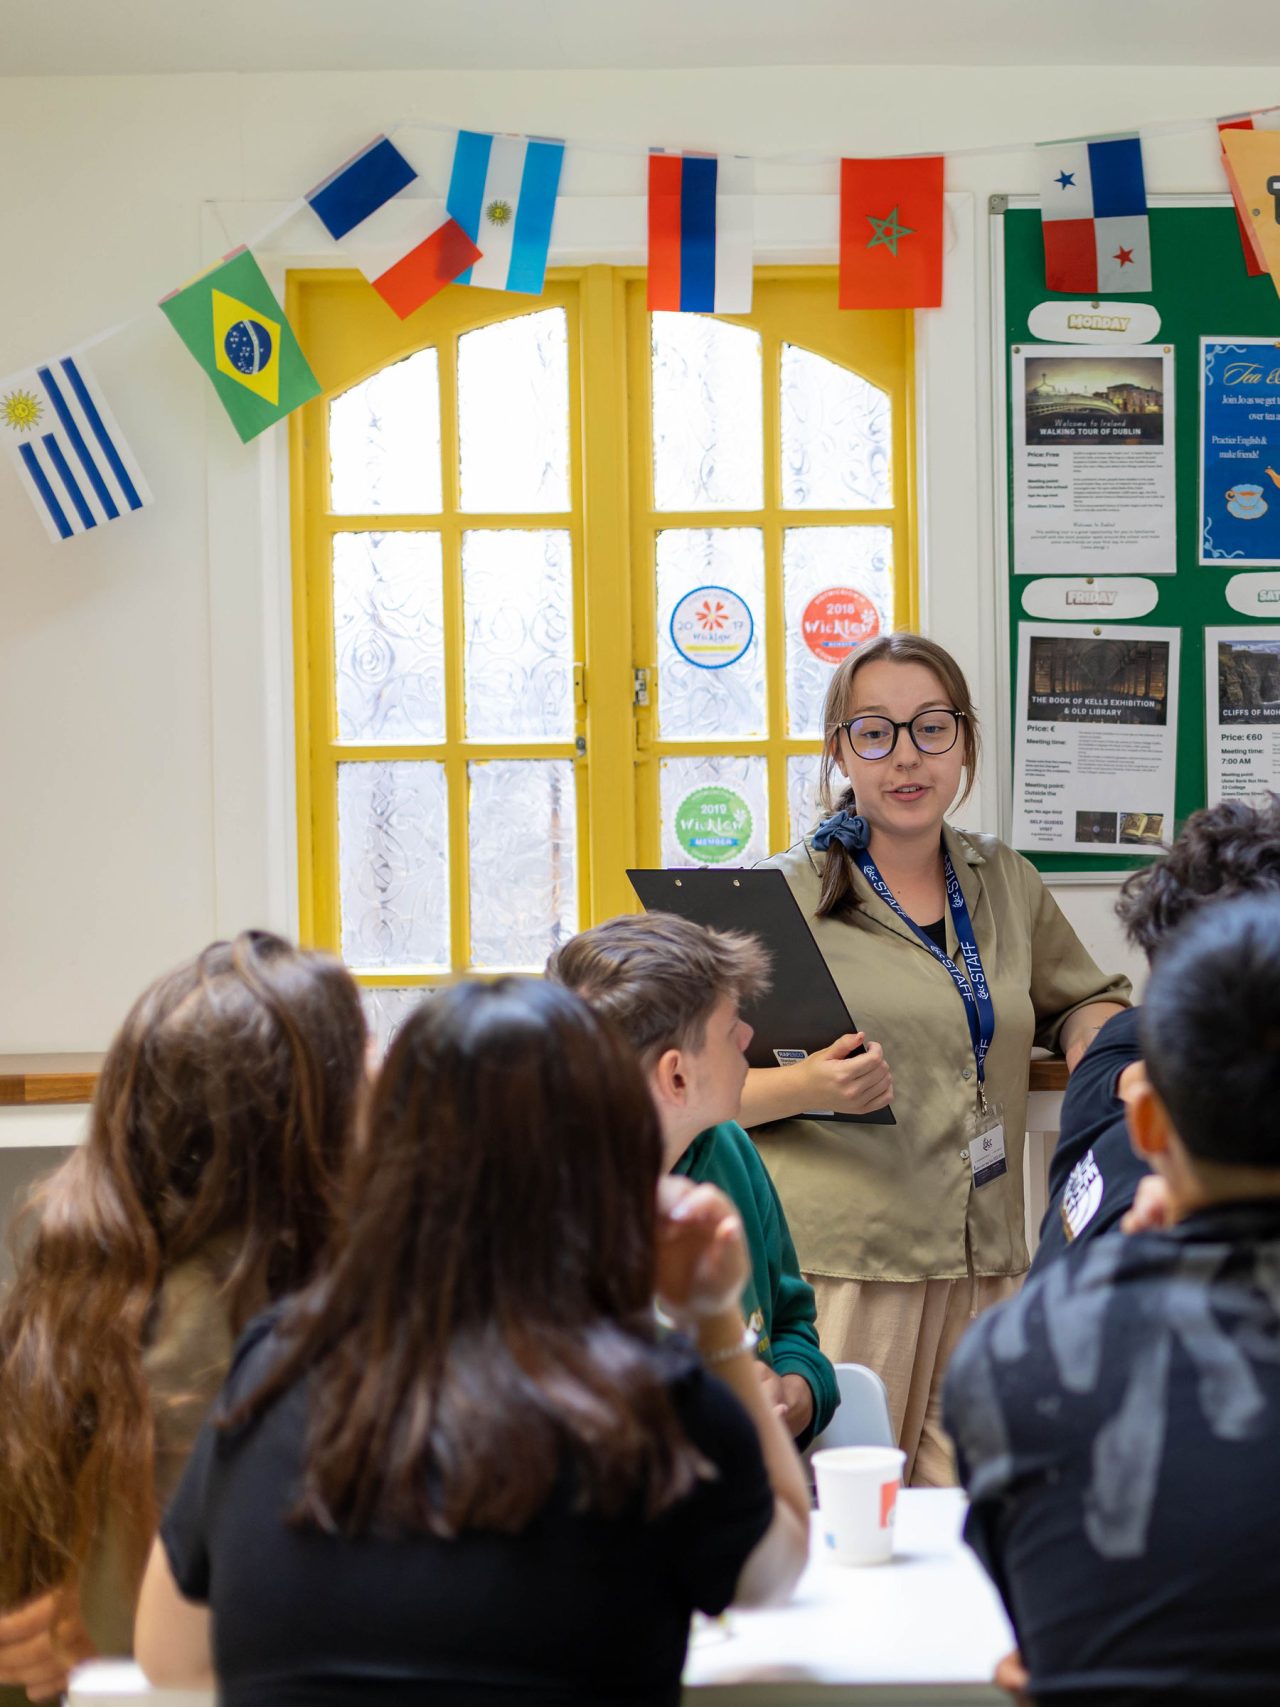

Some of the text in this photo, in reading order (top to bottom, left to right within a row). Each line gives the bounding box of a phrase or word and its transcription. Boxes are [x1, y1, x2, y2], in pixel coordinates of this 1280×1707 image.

[1223, 362, 1264, 386] Tea
[1054, 419, 1087, 427] Welcome
[1100, 419, 1126, 427] Ireland
[1040, 428, 1076, 436] WALKING
[1066, 590, 1118, 605] FRIDAY
[1085, 698, 1108, 706] KELLS
[1110, 699, 1155, 708] EXHIBITION
[1089, 708, 1122, 716] LIBRARY
[1027, 725, 1049, 733] Price:
[873, 881, 909, 918] STAFF
[961, 942, 985, 982] STAFF
[942, 959, 975, 1002] STAFF
